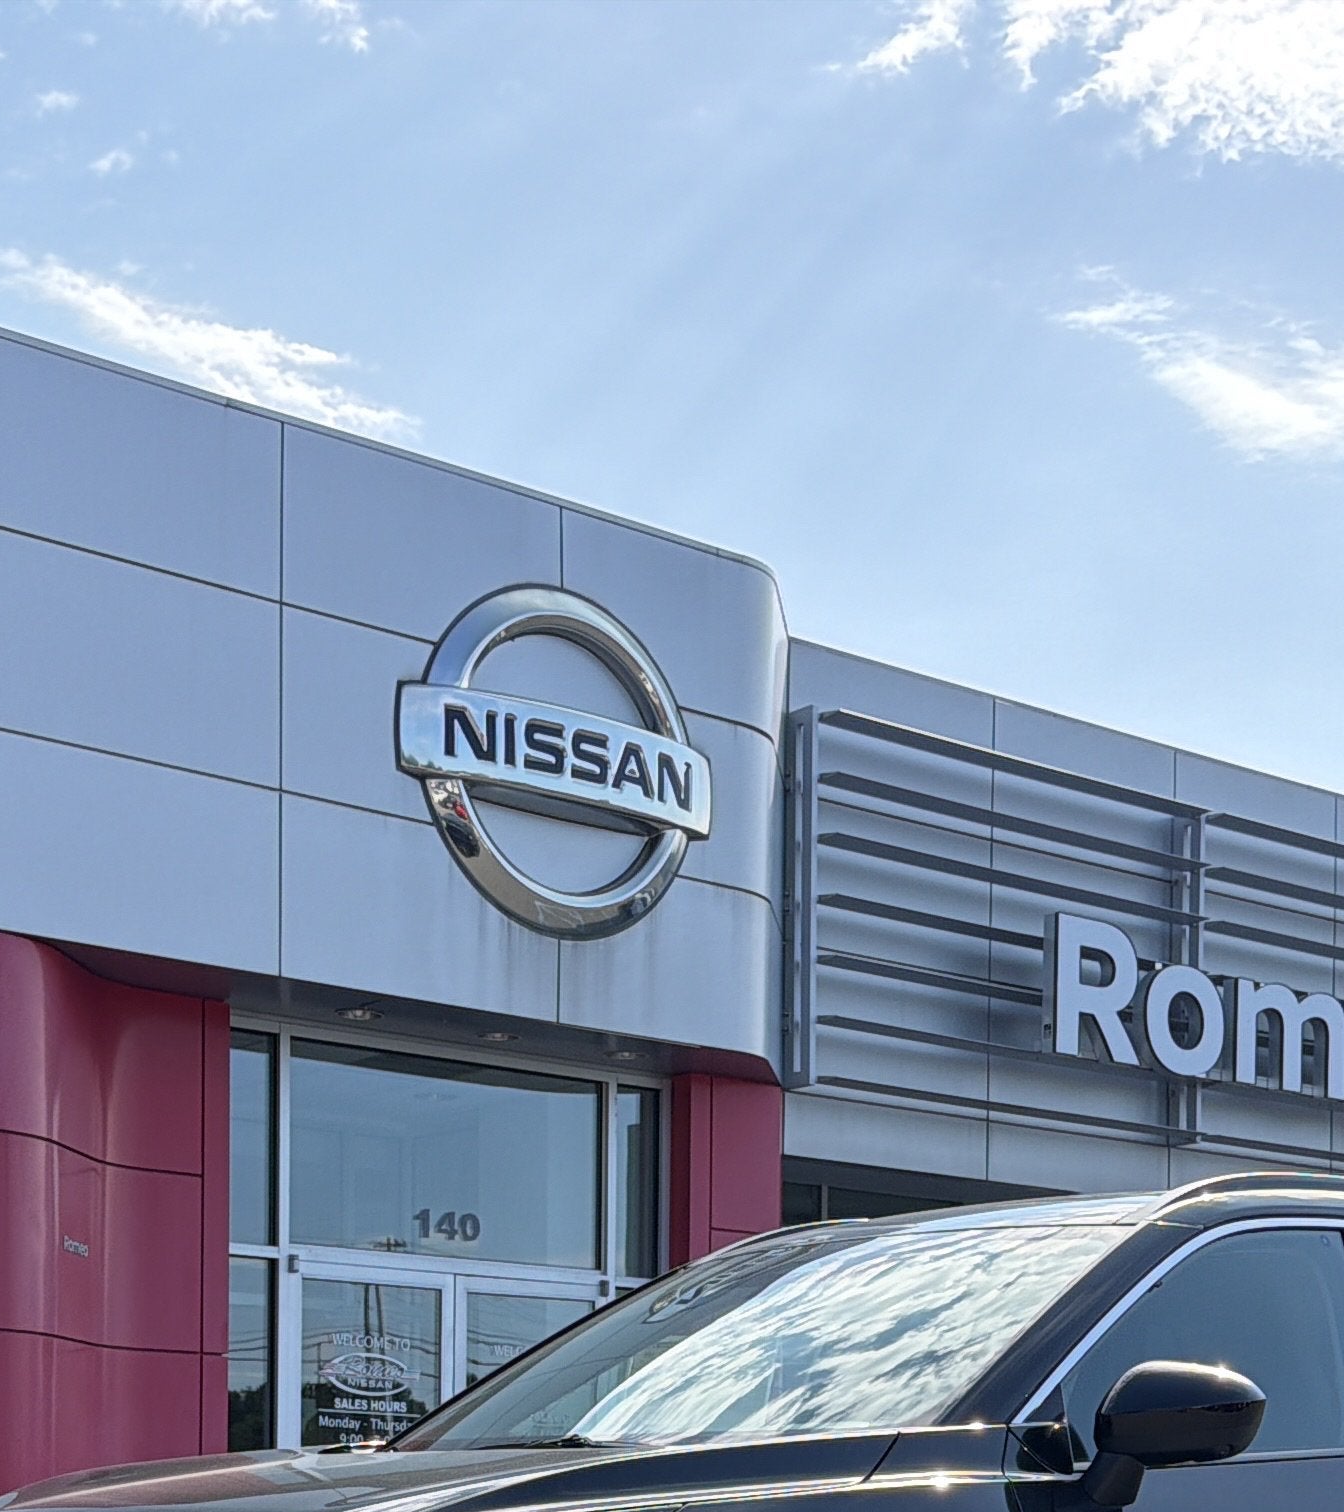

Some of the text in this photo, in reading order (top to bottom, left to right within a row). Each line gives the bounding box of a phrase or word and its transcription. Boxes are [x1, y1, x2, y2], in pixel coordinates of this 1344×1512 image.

[443, 703, 693, 813] NISSAN
[413, 1208, 480, 1242] 140
[332, 1333, 411, 1351] WELCOME TO
[494, 1345, 527, 1357] WELC
[347, 1377, 393, 1390] NISSAN
[334, 1397, 408, 1413] SALES HOURS
[319, 1414, 361, 1430] Monday
